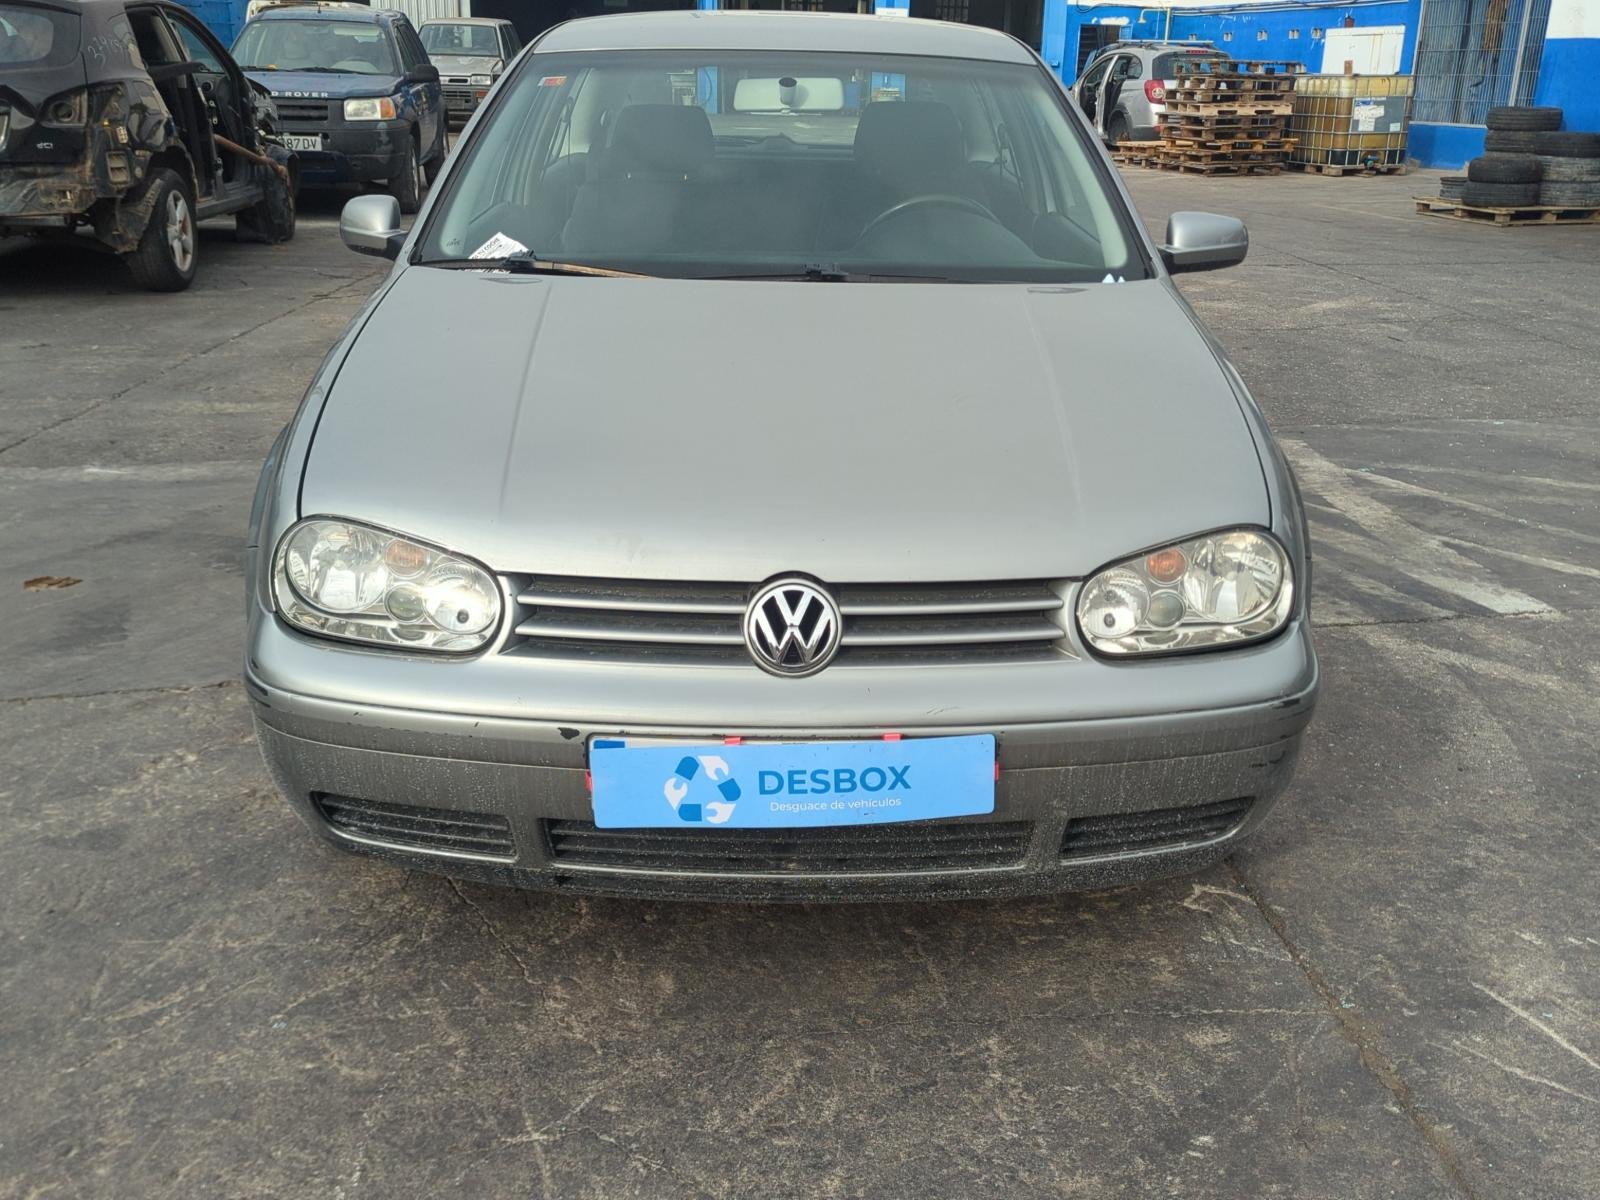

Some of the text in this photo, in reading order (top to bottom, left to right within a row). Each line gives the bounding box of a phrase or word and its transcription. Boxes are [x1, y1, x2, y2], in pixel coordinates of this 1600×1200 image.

[758, 765, 912, 795] DESBOX
[770, 797, 902, 813] Desguace de vehículos
